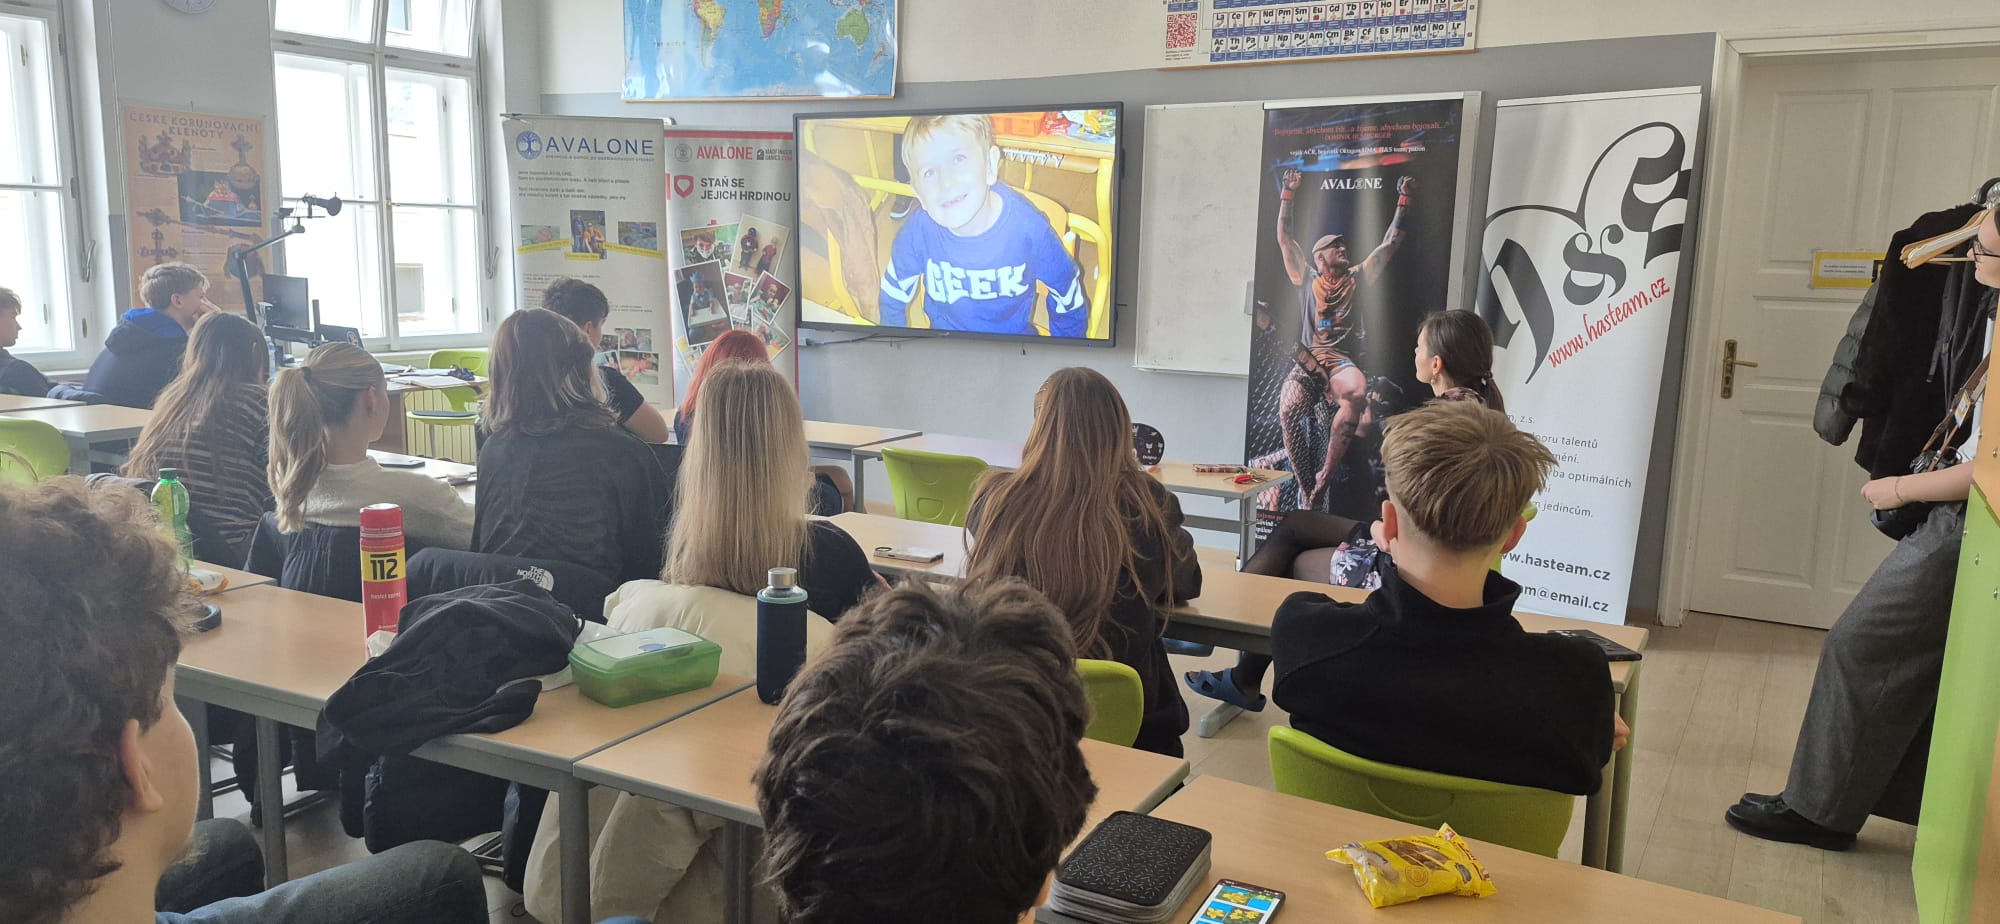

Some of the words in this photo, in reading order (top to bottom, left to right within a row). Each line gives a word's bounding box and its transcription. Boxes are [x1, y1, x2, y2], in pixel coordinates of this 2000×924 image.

[1363, 2, 1374, 10] Dy
[1214, 38, 1224, 46] Ac
[1277, 34, 1288, 42] Np
[1413, 24, 1426, 32] Md
[1432, 23, 1444, 31] No
[168, 126, 223, 138] KLENOTY
[545, 136, 655, 156] AVALONE
[696, 145, 754, 160] AVALONE
[700, 176, 729, 188] STAŇ
[731, 178, 745, 188] SE
[700, 190, 737, 200] JEJICH
[739, 191, 792, 202] HRDINOU
[926, 258, 1030, 305] GEEK
[1548, 277, 1671, 368] www.hasteam.cz
[1561, 436, 1599, 449] talentů
[1553, 452, 1580, 464] mění.
[1568, 471, 1632, 489] optimálních
[1541, 500, 1593, 518] jedincům.
[370, 558, 398, 581] 112
[1500, 552, 1611, 581] ww.hasteam.cz
[1520, 584, 1609, 612] m@email.cz
